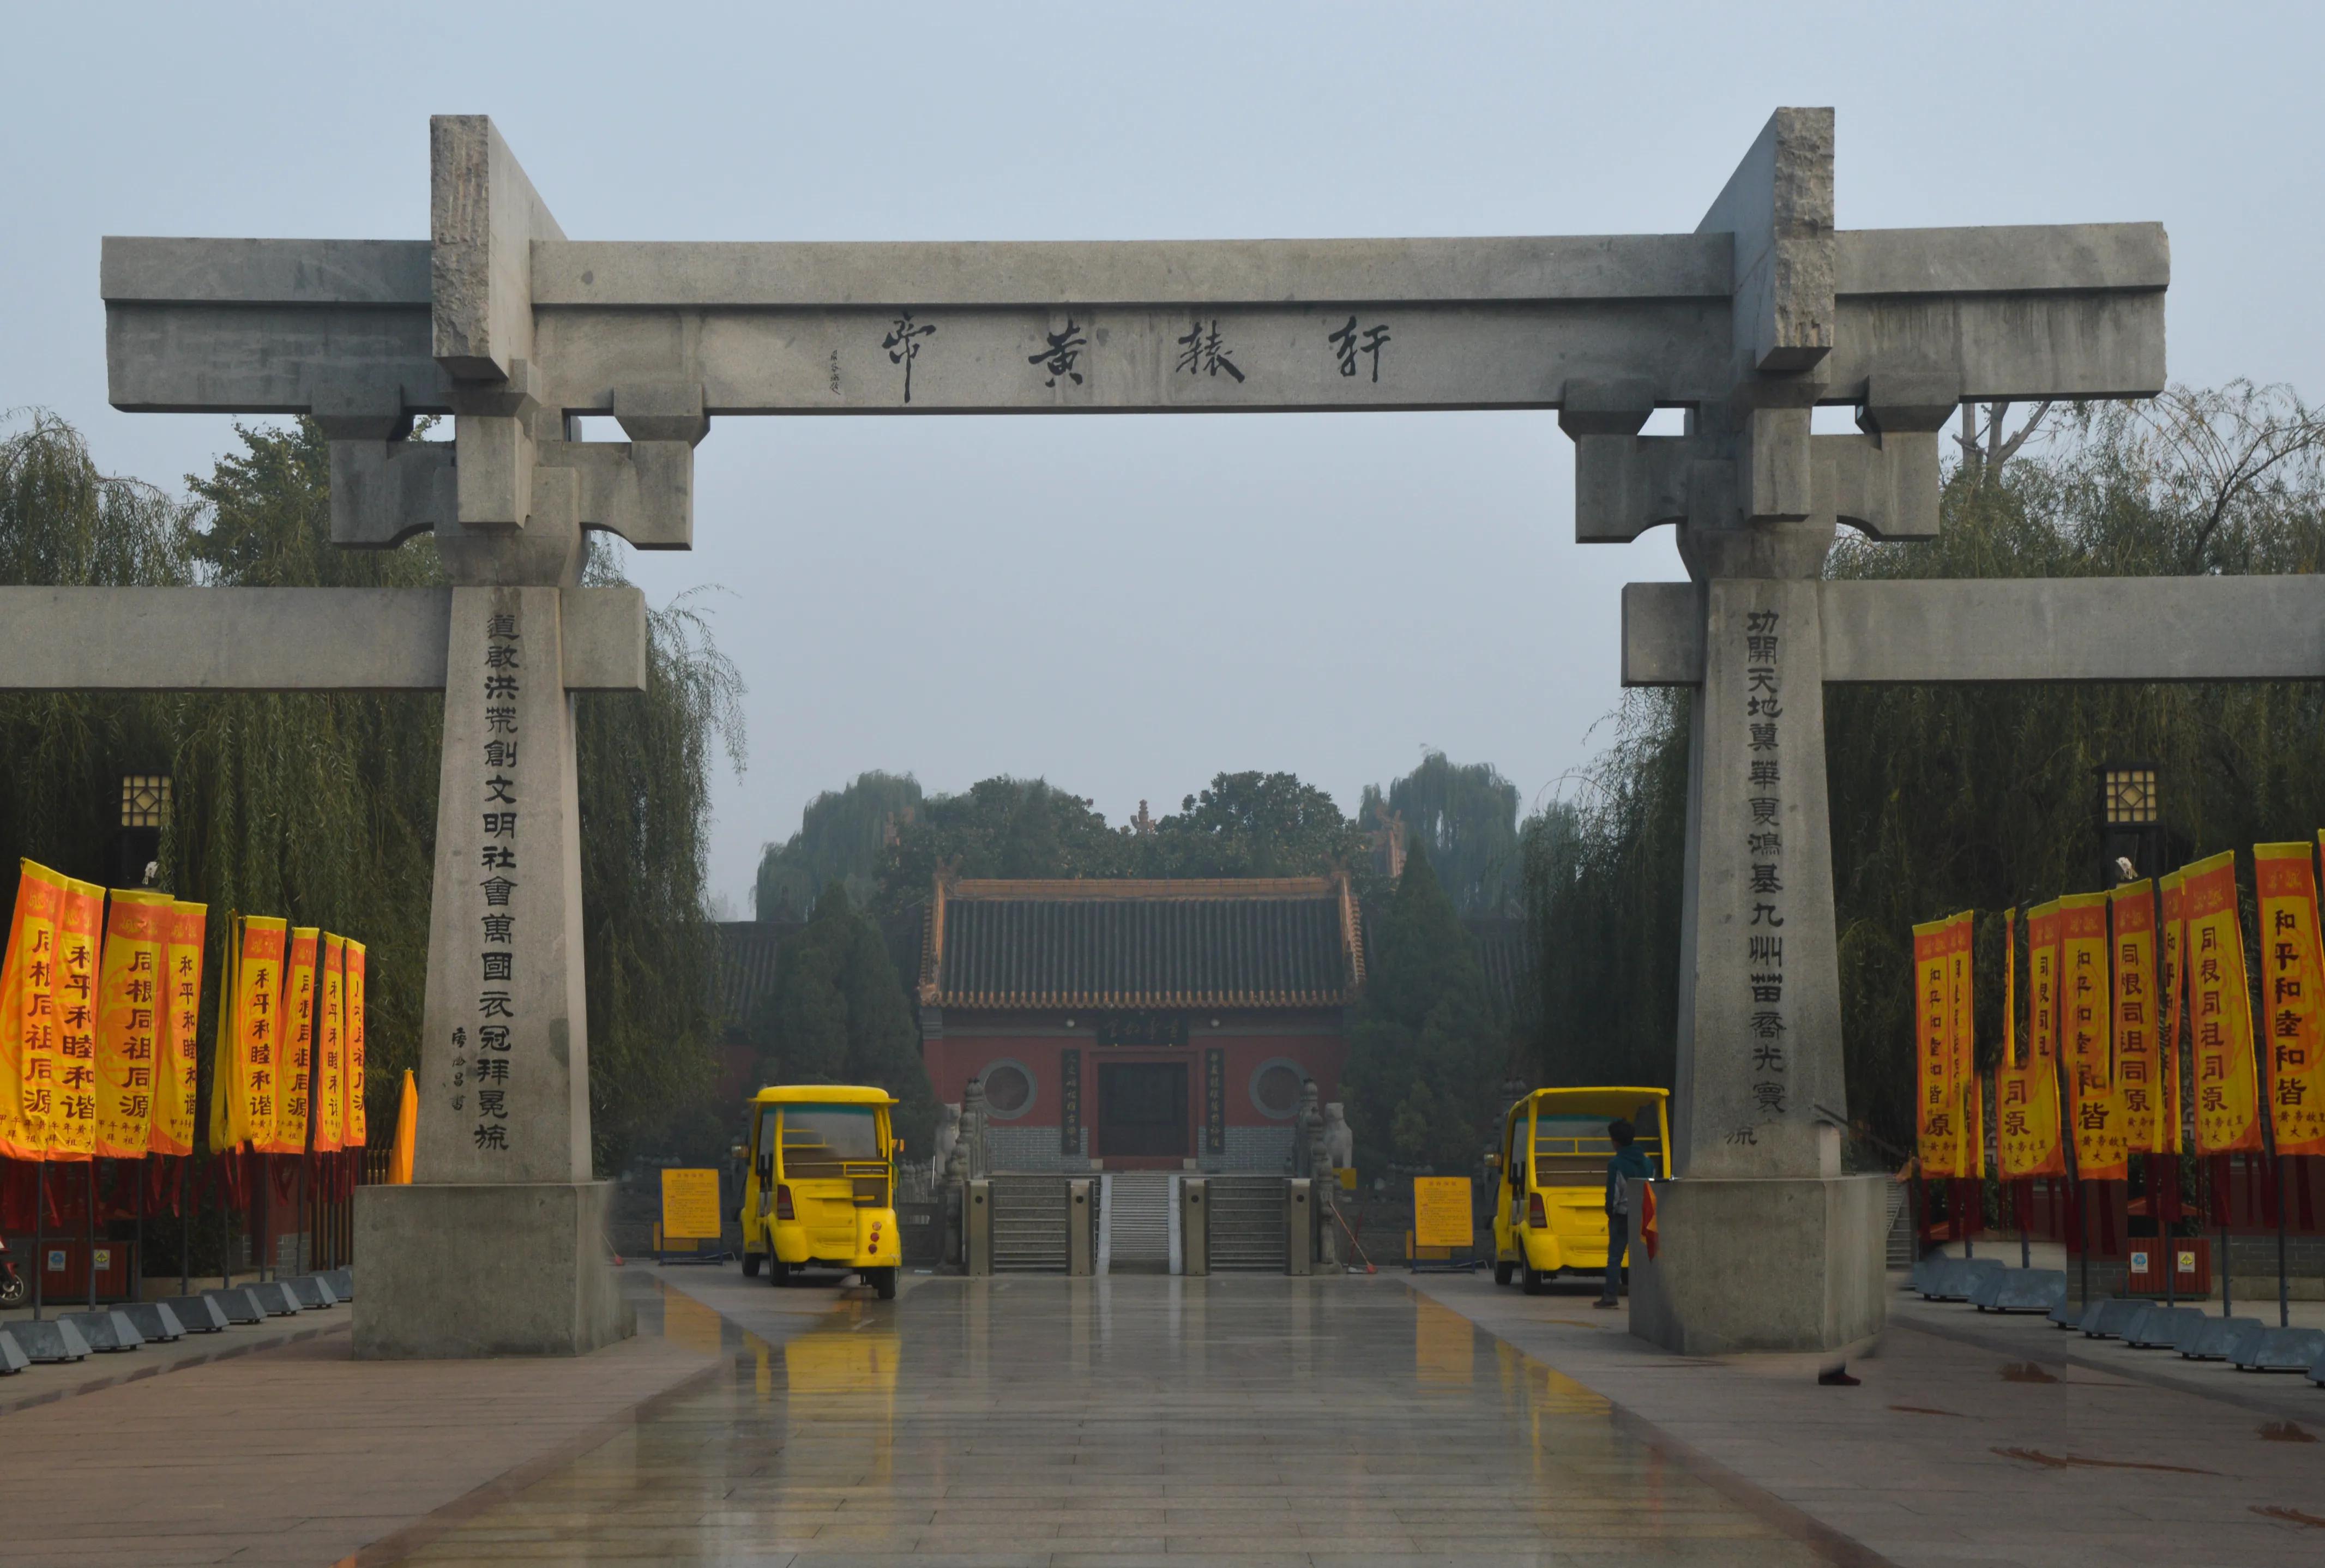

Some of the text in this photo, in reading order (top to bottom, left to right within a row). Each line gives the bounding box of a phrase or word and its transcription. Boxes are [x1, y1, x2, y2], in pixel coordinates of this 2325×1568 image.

[119, 951, 153, 1118] 同根同祖同源
[98, 1119, 147, 1134] 甲午年黄
